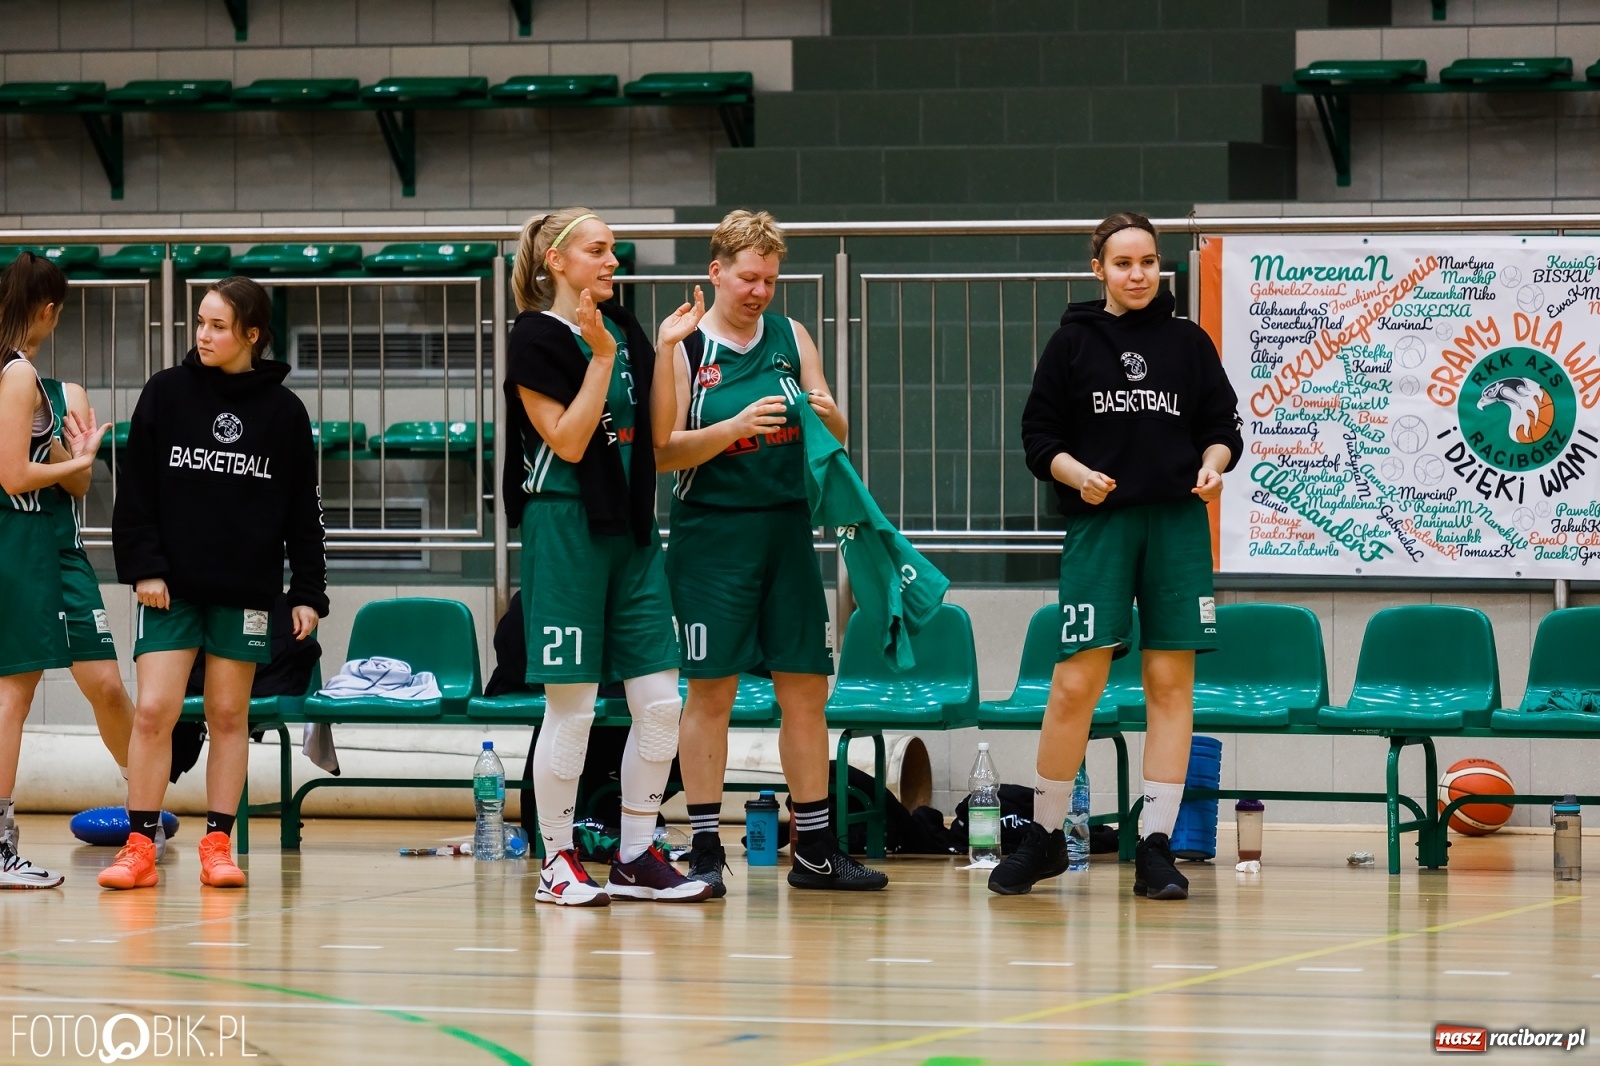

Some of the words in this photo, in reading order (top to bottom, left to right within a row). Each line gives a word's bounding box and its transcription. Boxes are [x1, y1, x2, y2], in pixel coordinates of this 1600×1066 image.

[1250, 254, 1393, 281] MarzenaN
[1437, 256, 1494, 275] Martyna
[1547, 255, 1597, 275] KasiaG
[1441, 270, 1496, 285] MarekP
[1533, 269, 1591, 283] BISKU
[1250, 281, 1347, 302] GabrielaZosiaL
[1329, 280, 1388, 315] JoachimL
[1413, 285, 1462, 300] Zuzanka
[1461, 286, 1496, 300] Miko
[1547, 284, 1585, 318] EwaK
[1249, 301, 1329, 316] AleksandraS
[1261, 315, 1344, 330] SenectusMed
[1377, 316, 1433, 330] KarinaL
[1250, 330, 1317, 349] GrzegorzP
[1251, 349, 1283, 370] Alicja
[1352, 344, 1393, 363] Stefka
[1427, 316, 1501, 407] GRAMY
[1514, 312, 1563, 354] DLA
[1251, 364, 1272, 379] Ala
[1352, 359, 1393, 374] Kamil
[1471, 352, 1513, 387] RKK
[1525, 355, 1563, 387] AZS
[1301, 380, 1344, 394] Dorota
[1354, 373, 1393, 394] AgaK
[1292, 394, 1341, 409] Dominik
[1340, 396, 1390, 410] BuszW
[1274, 407, 1338, 422] BartoszK
[1358, 411, 1388, 424] Busz
[1251, 421, 1320, 441] NastaszaG
[1337, 410, 1385, 443] NicolaB
[1251, 440, 1325, 461] AgnieszkaK
[1354, 441, 1391, 455] Varao
[1469, 429, 1567, 468] RACIBÓRZ
[169, 446, 272, 479] BASKETBALL
[1277, 453, 1341, 474] Krzysztof
[1343, 430, 1371, 501] JustynaM
[1289, 469, 1353, 484] KarolinaD
[1305, 483, 1345, 497] AniaP
[1399, 486, 1458, 502] MarcinP
[1250, 461, 1394, 562] AleksanderF
[1251, 490, 1288, 514] Elunia
[1307, 495, 1387, 515] MagdalenaF
[1414, 500, 1475, 520] ReginaM
[1250, 510, 1302, 527] Diabeusz
[1413, 514, 1474, 529] JaninaW
[1550, 517, 1600, 534] JakubK
[1250, 526, 1315, 540] BeataFran
[1376, 504, 1425, 563] GabrielaL
[1529, 531, 1568, 545] EwaO
[1456, 543, 1516, 558] TomaszK
[1061, 603, 1095, 643] 23
[543, 626, 583, 666] 27
[685, 622, 707, 661] 10
